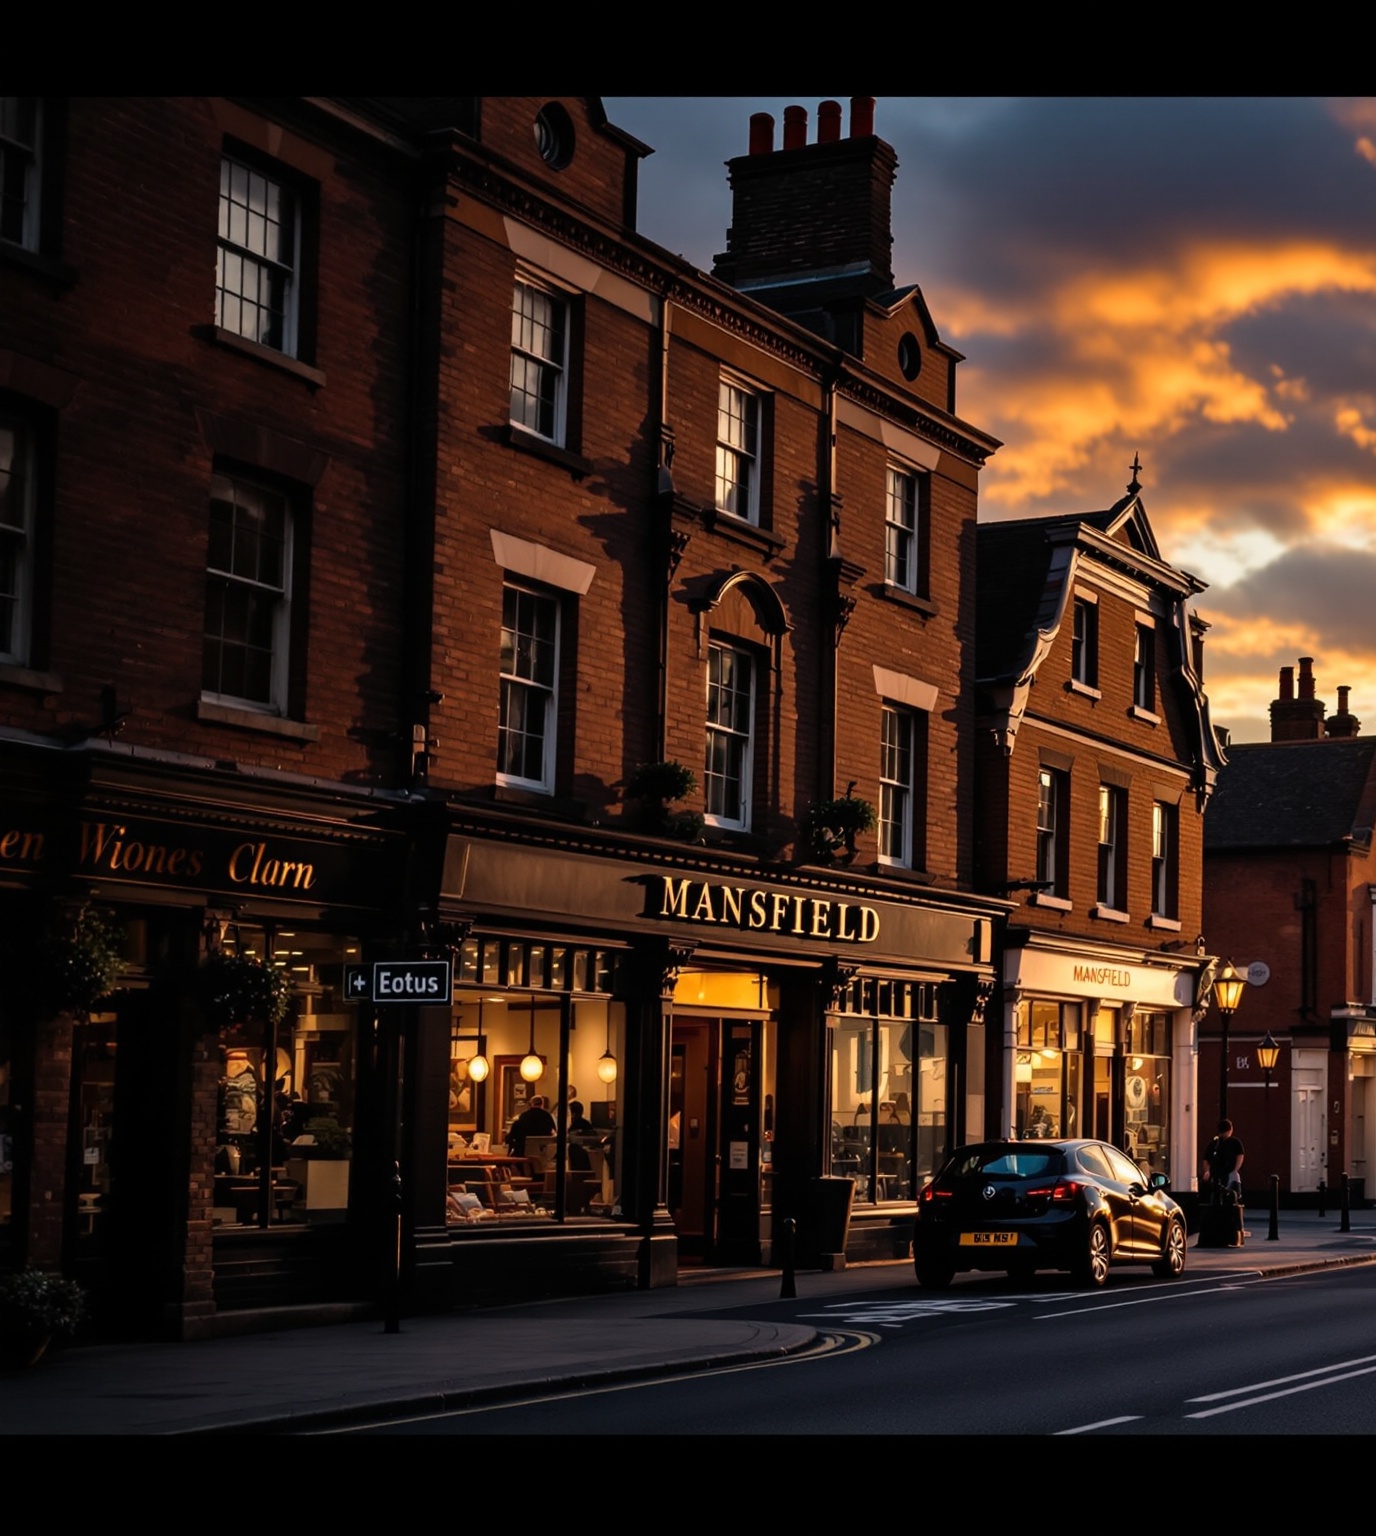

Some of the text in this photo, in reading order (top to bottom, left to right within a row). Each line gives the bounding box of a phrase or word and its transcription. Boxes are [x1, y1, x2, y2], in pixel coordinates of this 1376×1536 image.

[79, 821, 204, 877] Wiones
[659, 876, 880, 942] MANSFIELD
[379, 971, 438, 993] Eotus
